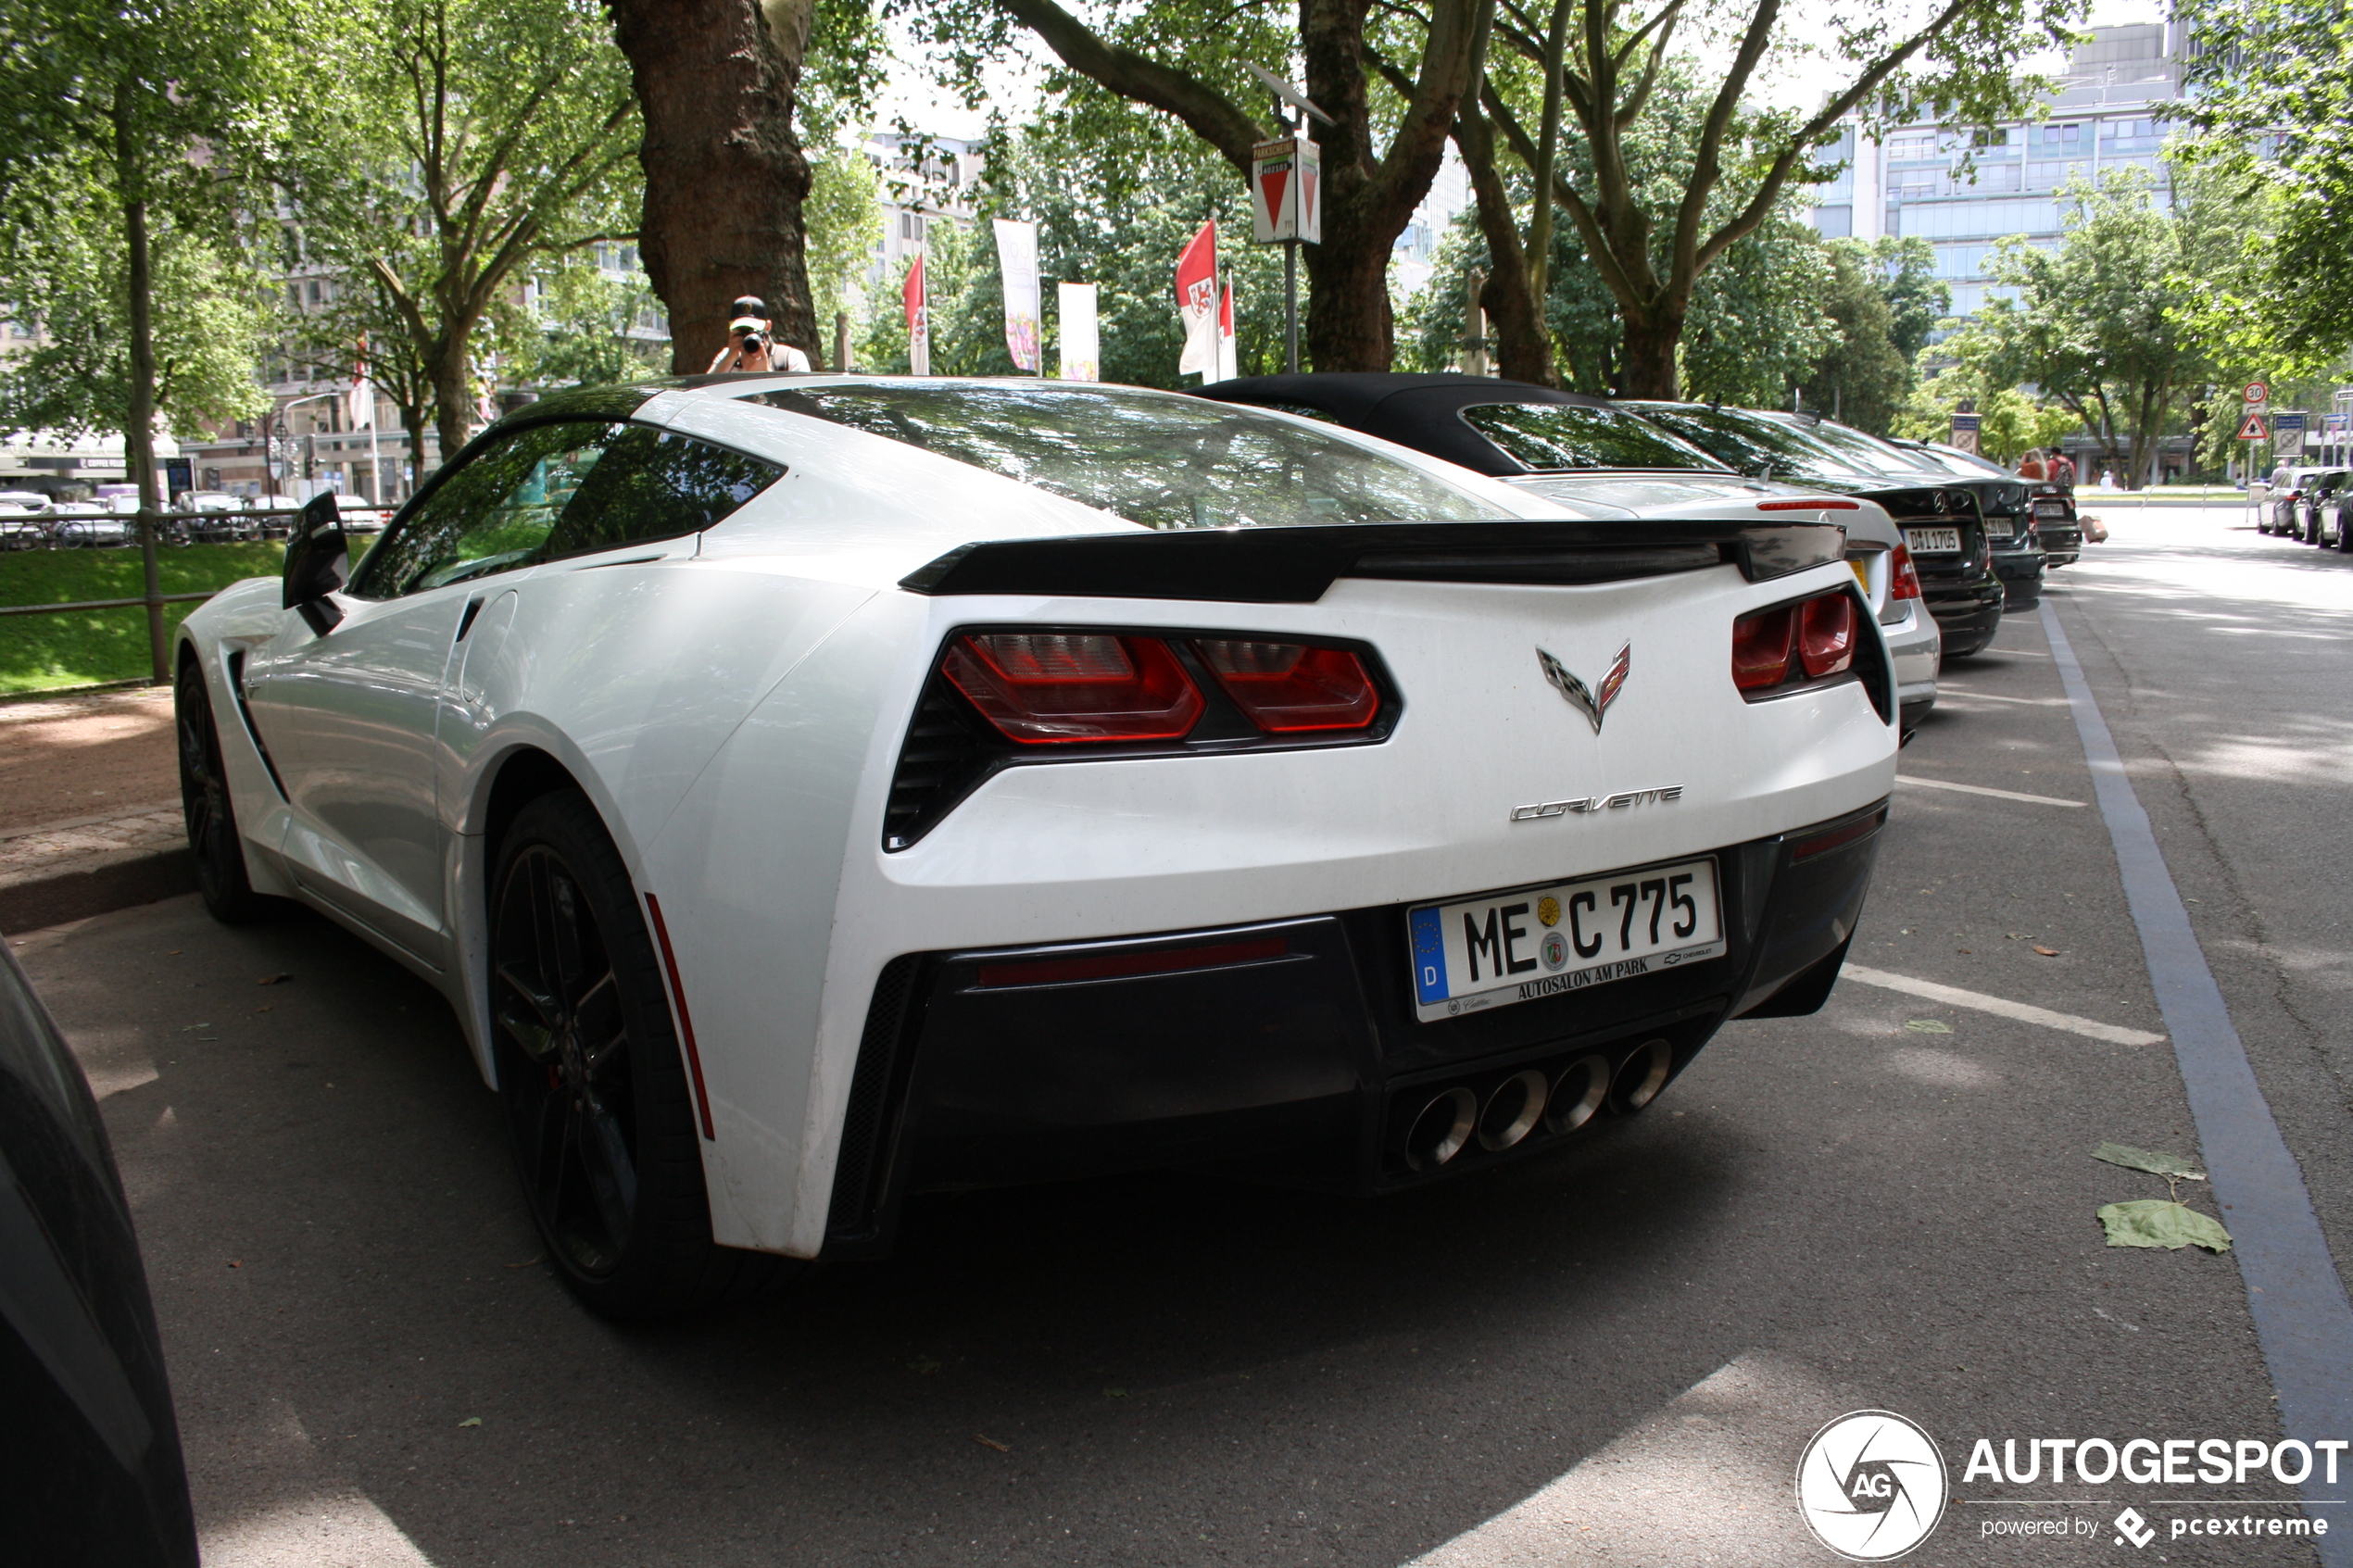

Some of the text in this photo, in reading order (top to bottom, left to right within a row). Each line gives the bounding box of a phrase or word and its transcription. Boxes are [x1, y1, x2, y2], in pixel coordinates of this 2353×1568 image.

[1253, 142, 1294, 159] PARKSCHEINE
[1263, 163, 1288, 175] 402103
[2247, 387, 2261, 398] 30
[1910, 531, 1919, 550] D
[1931, 530, 1957, 549] 1705
[1510, 784, 1685, 821] CORVETTE
[1464, 872, 1696, 982] ME C 775
[1682, 947, 1713, 960] CHEVROLET
[1424, 965, 1437, 987] D
[1518, 958, 1649, 1002] AUTOSALON AM PARK
[1463, 997, 1491, 1011] Cadillac
